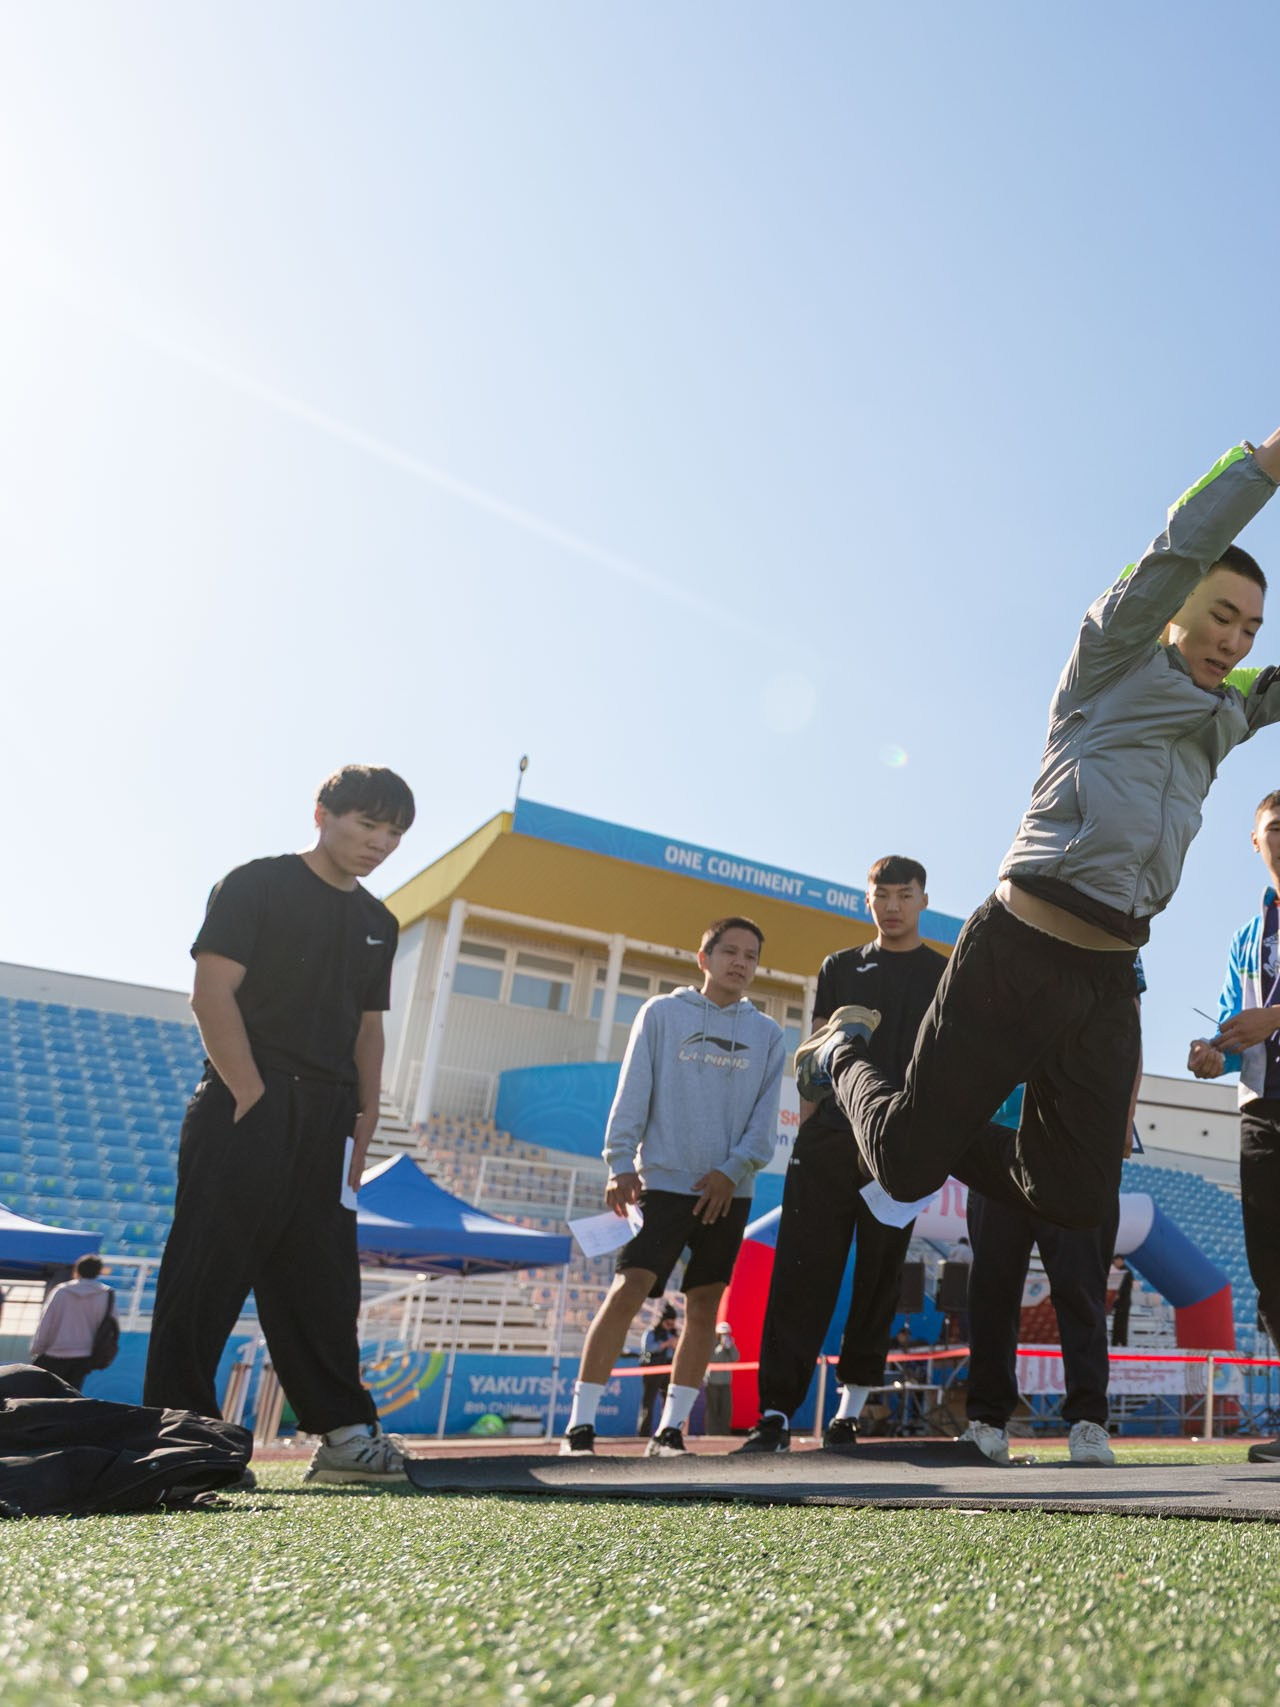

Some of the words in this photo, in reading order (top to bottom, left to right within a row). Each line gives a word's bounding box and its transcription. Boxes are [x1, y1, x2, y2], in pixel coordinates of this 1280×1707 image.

[665, 845, 704, 870] ONE
[707, 857, 805, 896] CONTINENT
[826, 889, 859, 912] ONE
[469, 1375, 566, 1396] YAKUTSK
